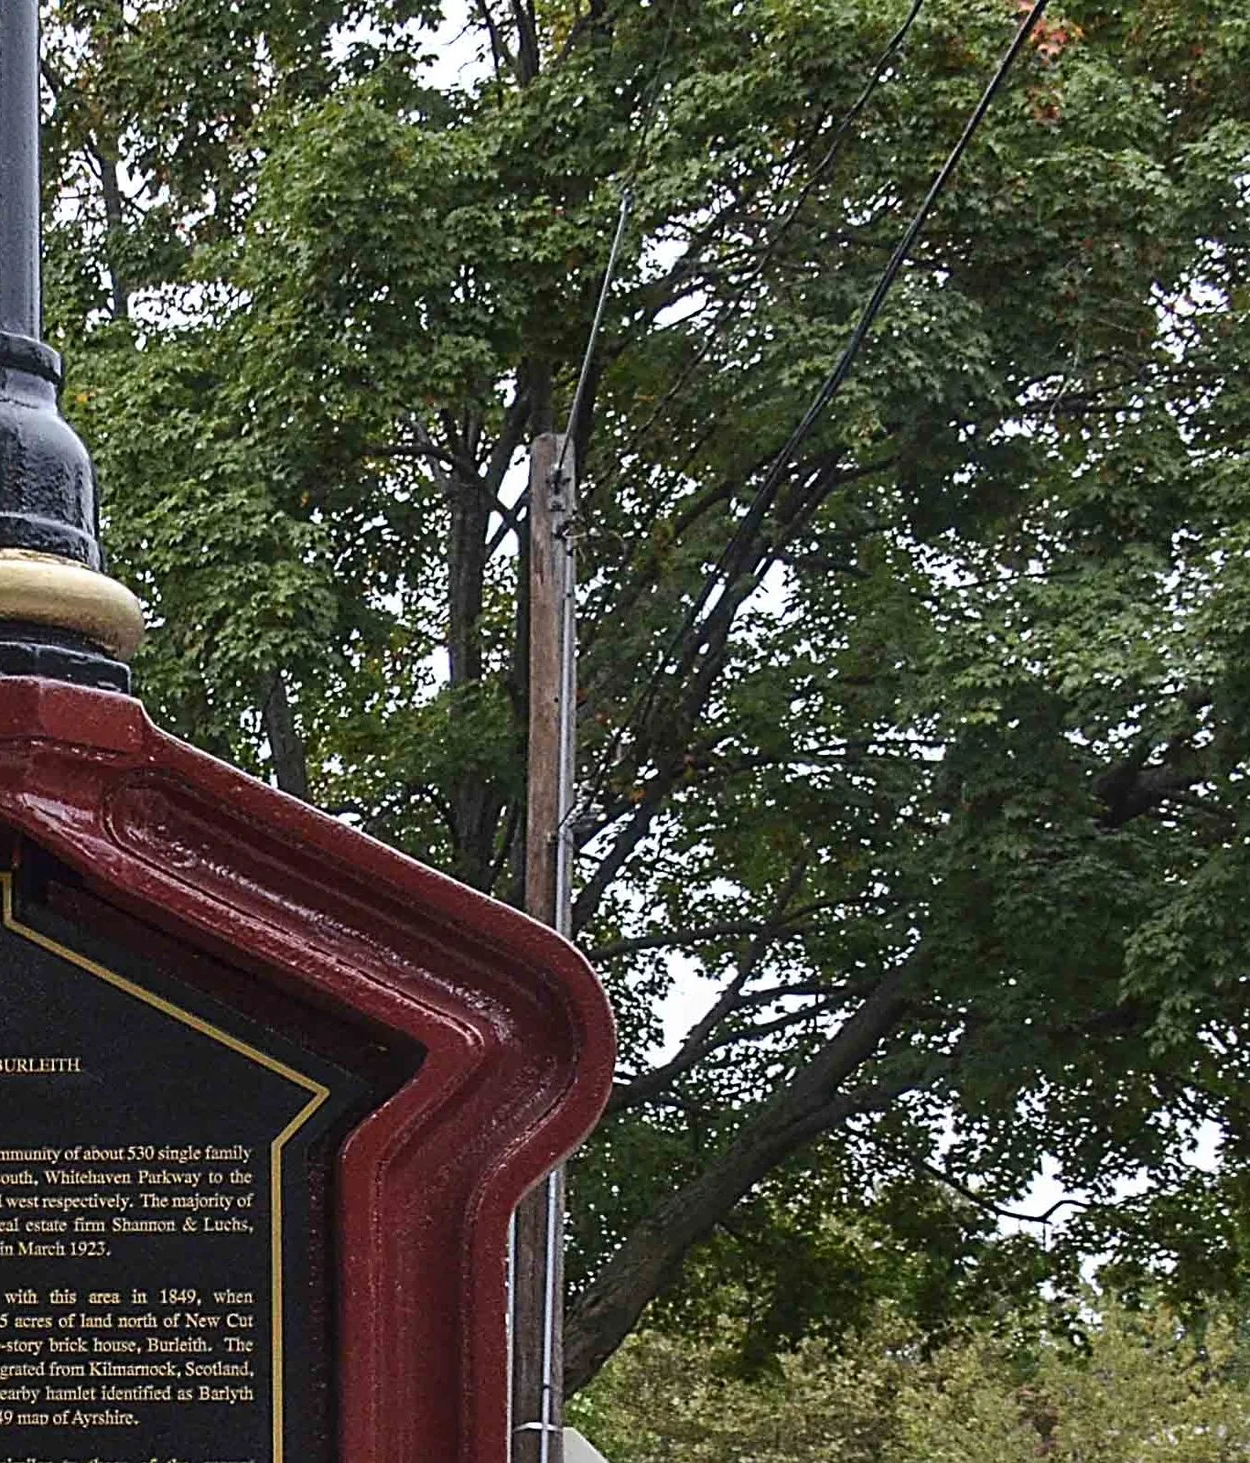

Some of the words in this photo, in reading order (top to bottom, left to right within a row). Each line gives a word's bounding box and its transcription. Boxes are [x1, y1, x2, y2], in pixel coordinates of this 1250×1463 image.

[65, 1146, 81, 1160] of
[83, 1146, 125, 1160] about
[127, 1146, 154, 1160] 530
[158, 1146, 201, 1163] single
[205, 1145, 251, 1164] family
[44, 1169, 131, 1184] Whitehaven
[138, 1170, 201, 1187] Parkway
[209, 1172, 223, 1183] to
[230, 1169, 252, 1183] the
[26, 1220, 67, 1232] estate
[74, 1217, 105, 1232] firm
[112, 1217, 175, 1232] Shannon
[183, 1217, 197, 1231] &
[204, 1217, 253, 1232] Luchs,
[0, 1241, 13, 1255] in
[19, 1241, 66, 1255] March
[71, 1241, 111, 1256] 1923.
[5, 1289, 38, 1304] with
[50, 1289, 76, 1303] this
[89, 1293, 120, 1303] area
[132, 1289, 147, 1303] in
[161, 1289, 201, 1305] 1849,
[214, 1289, 252, 1303] when
[49, 1337, 88, 1352] brick
[93, 1337, 141, 1354] house,
[147, 1337, 212, 1352] Burleith.
[224, 1337, 253, 1352] The
[46, 1386, 95, 1400] hamlet
[101, 1385, 171, 1400] identified
[178, 1389, 192, 1400] as
[199, 1386, 253, 1404] Barlyth
[18, 1414, 49, 1427] map
[53, 1410, 70, 1424] of
[71, 1410, 138, 1428] Ayrshire.
